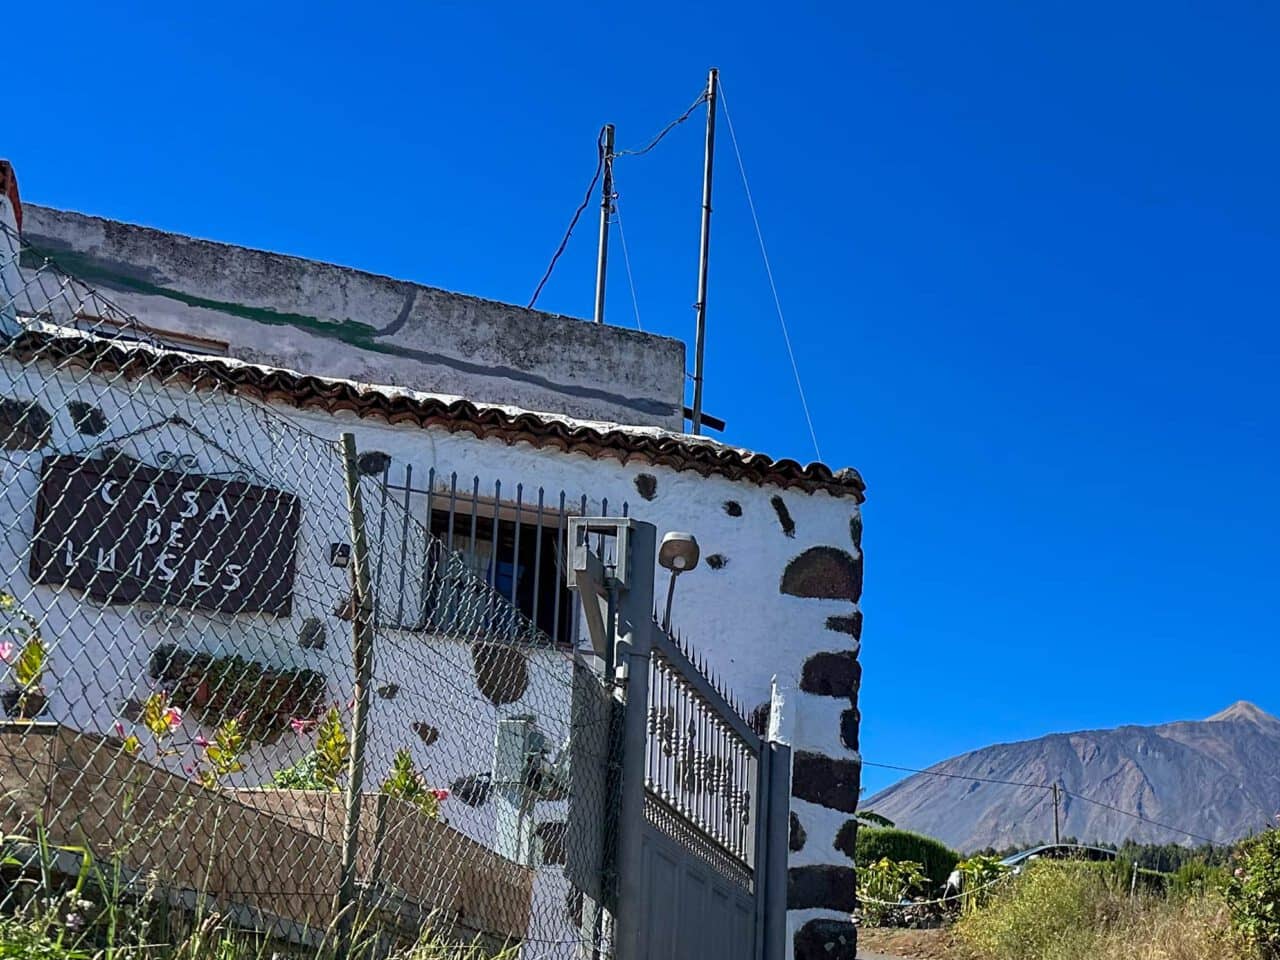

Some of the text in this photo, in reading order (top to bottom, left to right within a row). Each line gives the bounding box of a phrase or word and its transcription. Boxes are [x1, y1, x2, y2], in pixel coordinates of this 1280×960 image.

[101, 479, 233, 522] CASA
[146, 518, 185, 549] DE
[64, 539, 244, 592] LUISES
